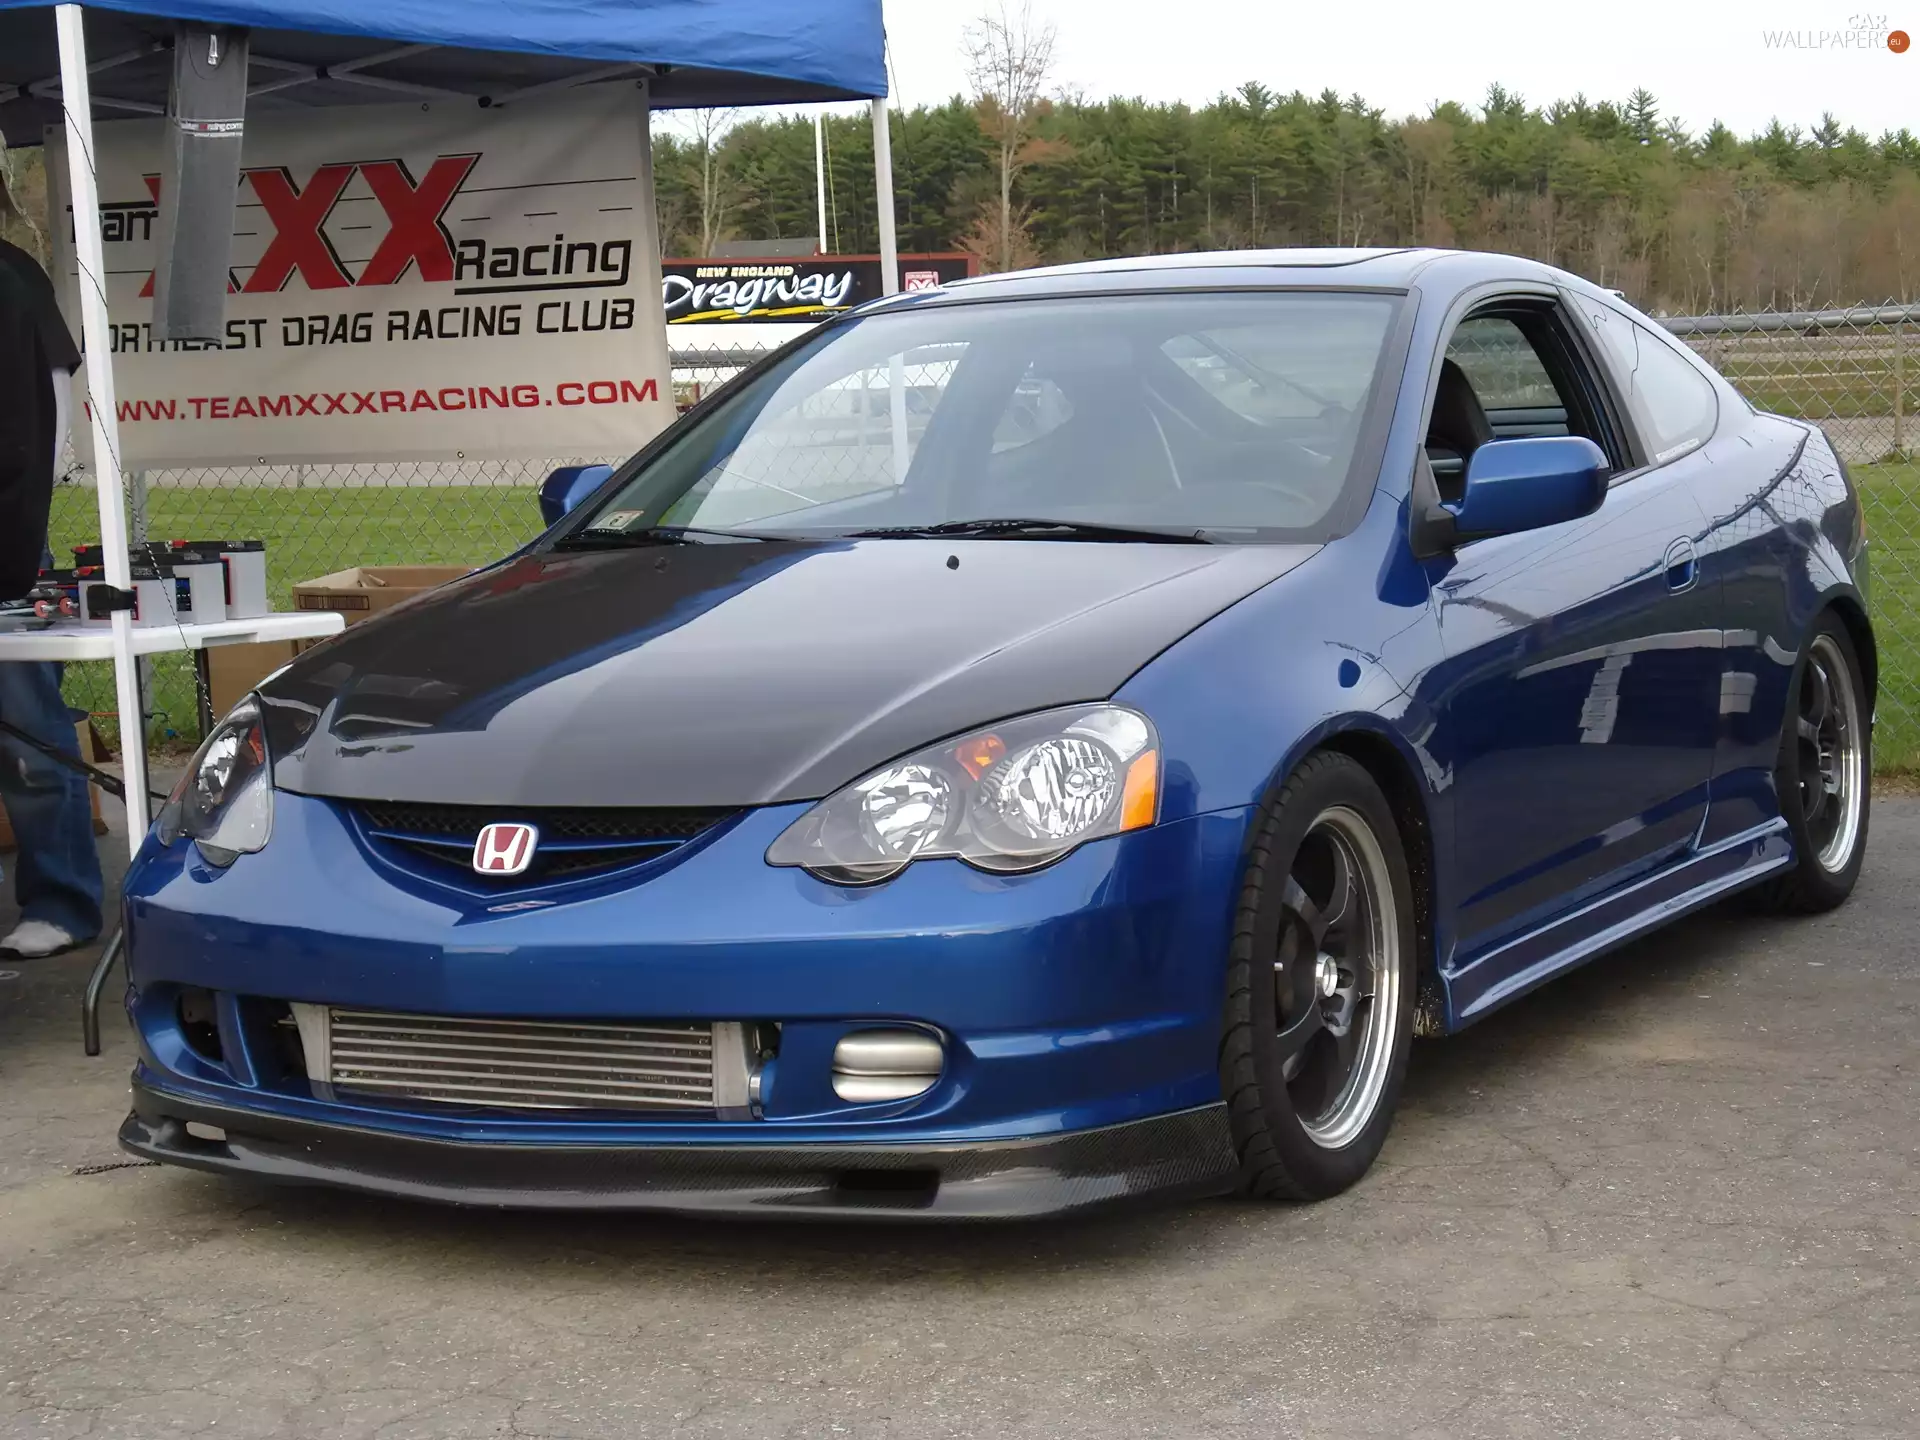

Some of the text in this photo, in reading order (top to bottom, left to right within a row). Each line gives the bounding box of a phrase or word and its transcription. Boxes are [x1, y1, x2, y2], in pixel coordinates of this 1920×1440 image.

[138, 153, 483, 298] XX
[454, 234, 632, 295] Racing
[662, 271, 852, 316] Dragway
[696, 266, 794, 278] NEW ENGLAND
[81, 298, 635, 353] ORTST DRAG RACING CLUB
[84, 379, 658, 422] WW.TEAMXXXRACING.COM
